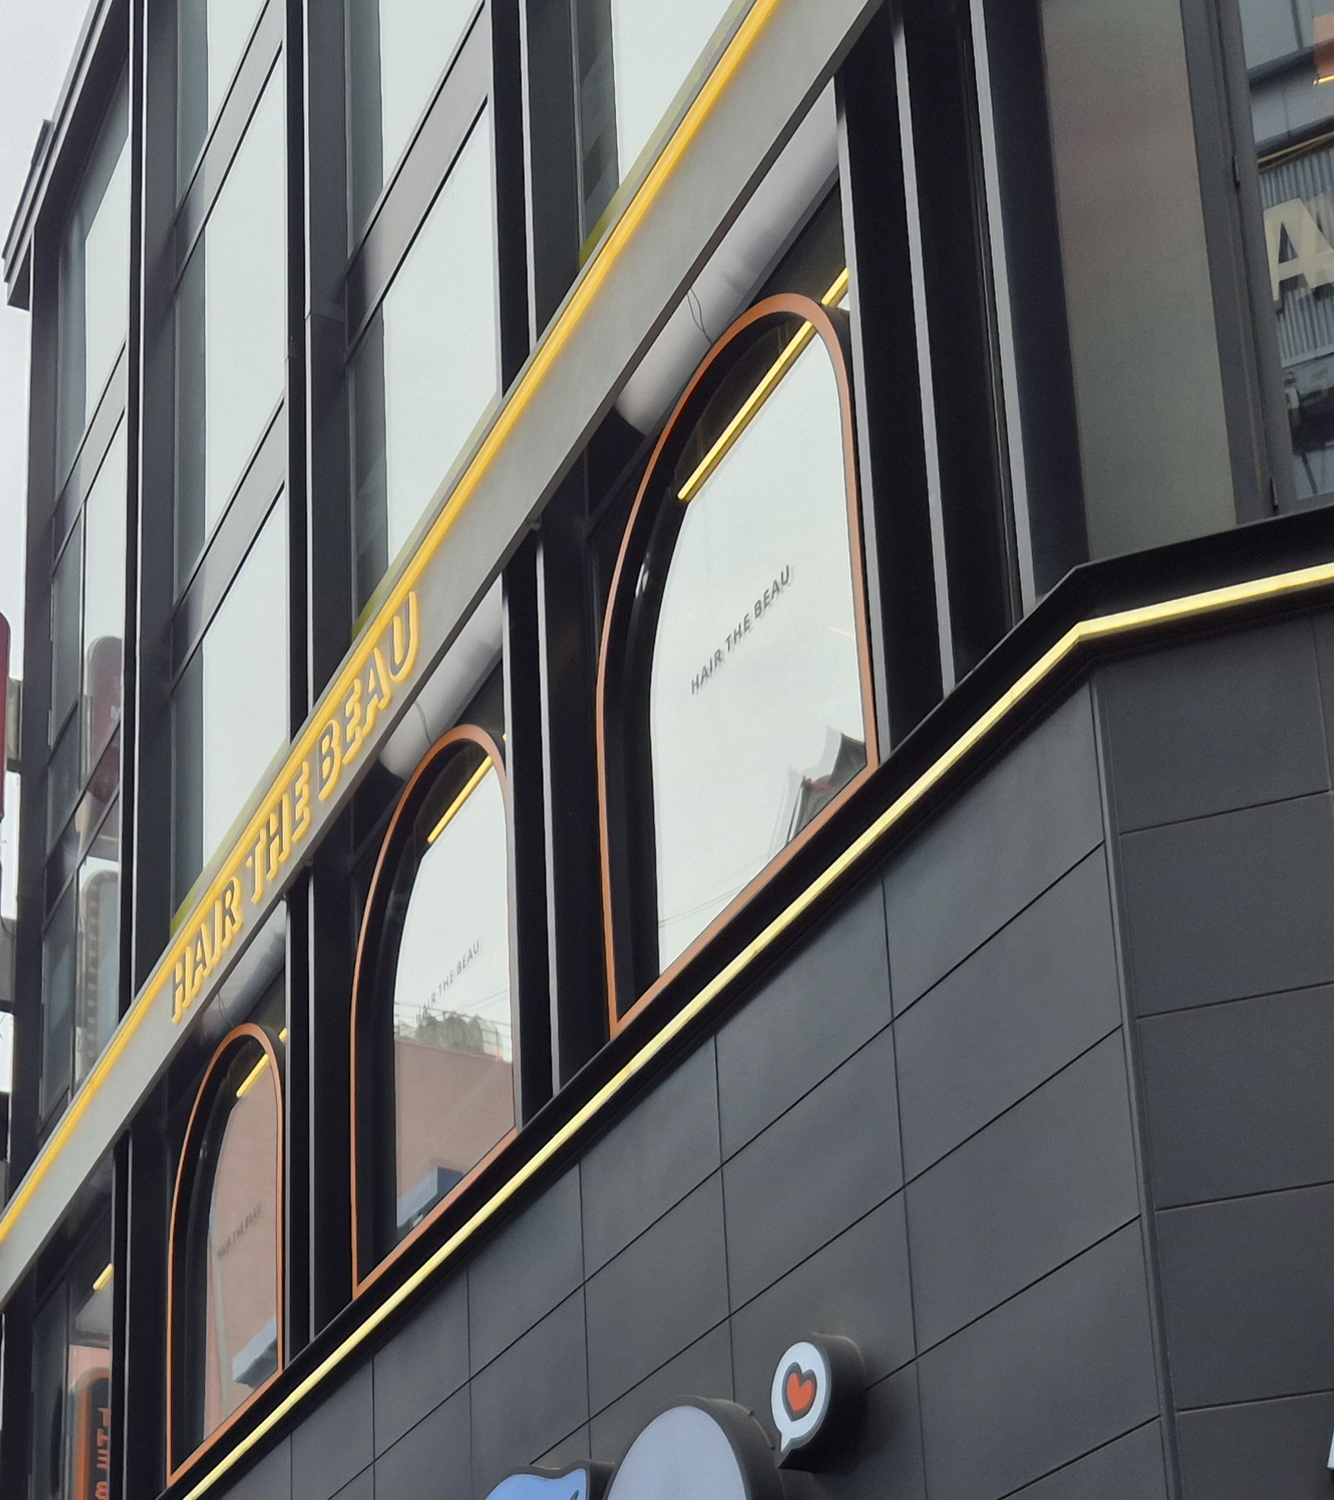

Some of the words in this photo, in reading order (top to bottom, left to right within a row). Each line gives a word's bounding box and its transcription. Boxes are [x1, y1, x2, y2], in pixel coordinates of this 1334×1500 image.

[691, 648, 723, 695] HAIR
[724, 612, 751, 652] THE
[754, 564, 790, 619] BEAU
[171, 875, 244, 1024] HAIR
[246, 761, 310, 903] THE
[317, 591, 420, 803] BEAU
[438, 969, 454, 997] THE
[456, 938, 480, 976] BEAU
